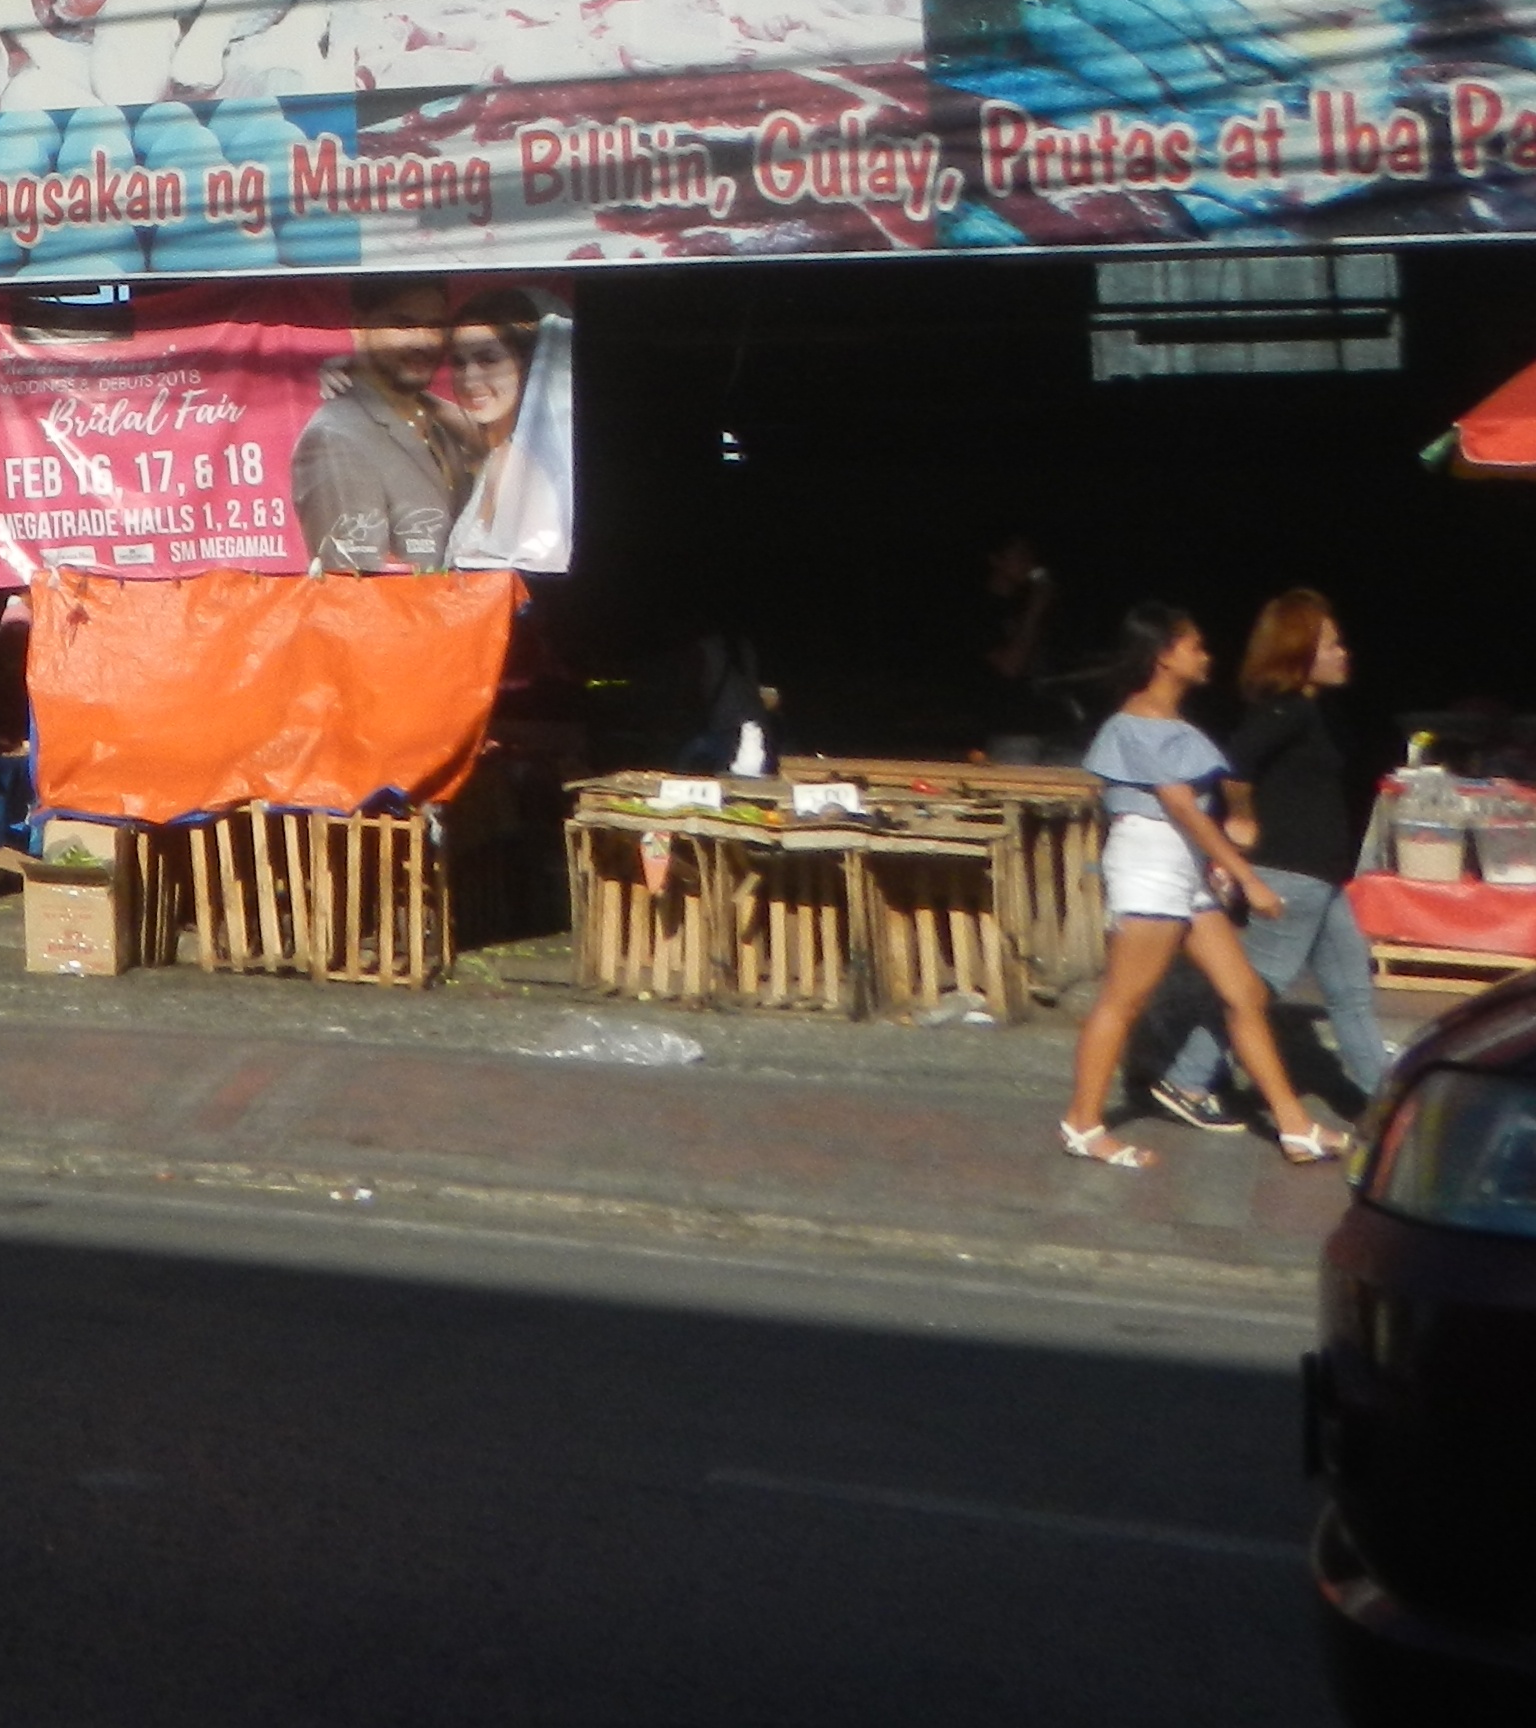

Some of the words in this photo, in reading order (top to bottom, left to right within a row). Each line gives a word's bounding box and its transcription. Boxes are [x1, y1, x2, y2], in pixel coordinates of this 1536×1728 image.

[207, 164, 265, 233] ng
[291, 135, 493, 226] Murang
[520, 122, 731, 218] Bilihin,
[755, 112, 963, 218] Gulay,
[983, 102, 1195, 193] Prutas
[1222, 106, 1284, 181] at
[1313, 87, 1426, 177] Iba
[99, 374, 154, 391] DEBUTS
[157, 369, 201, 387] 2018
[41, 389, 169, 442] Bridal
[171, 389, 248, 430] Fair
[5, 455, 63, 500] FEB
[135, 450, 186, 497] 17,
[195, 453, 214, 491] &
[224, 443, 264, 485] 18
[124, 504, 195, 535] HALLS
[271, 498, 285, 527] 3
[170, 540, 197, 563] SM
[200, 534, 287, 560] MEGAMALL
